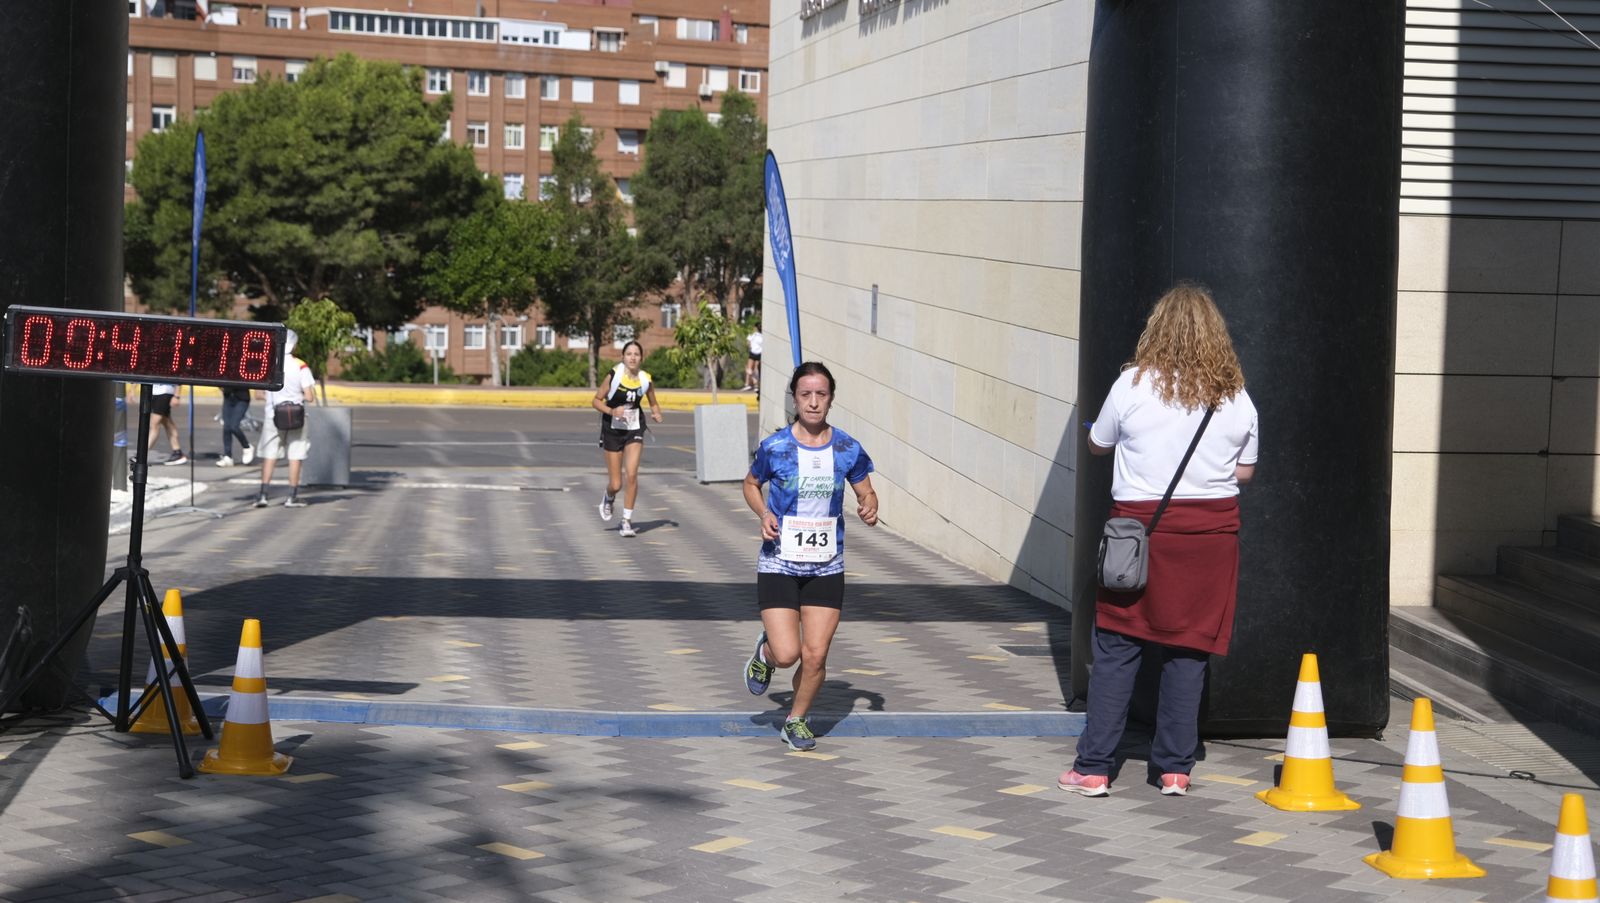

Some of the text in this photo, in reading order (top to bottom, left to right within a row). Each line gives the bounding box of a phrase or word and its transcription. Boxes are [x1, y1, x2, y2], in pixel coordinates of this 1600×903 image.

[21, 316, 271, 380] 00:41:18
[626, 390, 636, 402] 21
[794, 532, 829, 547] 143
